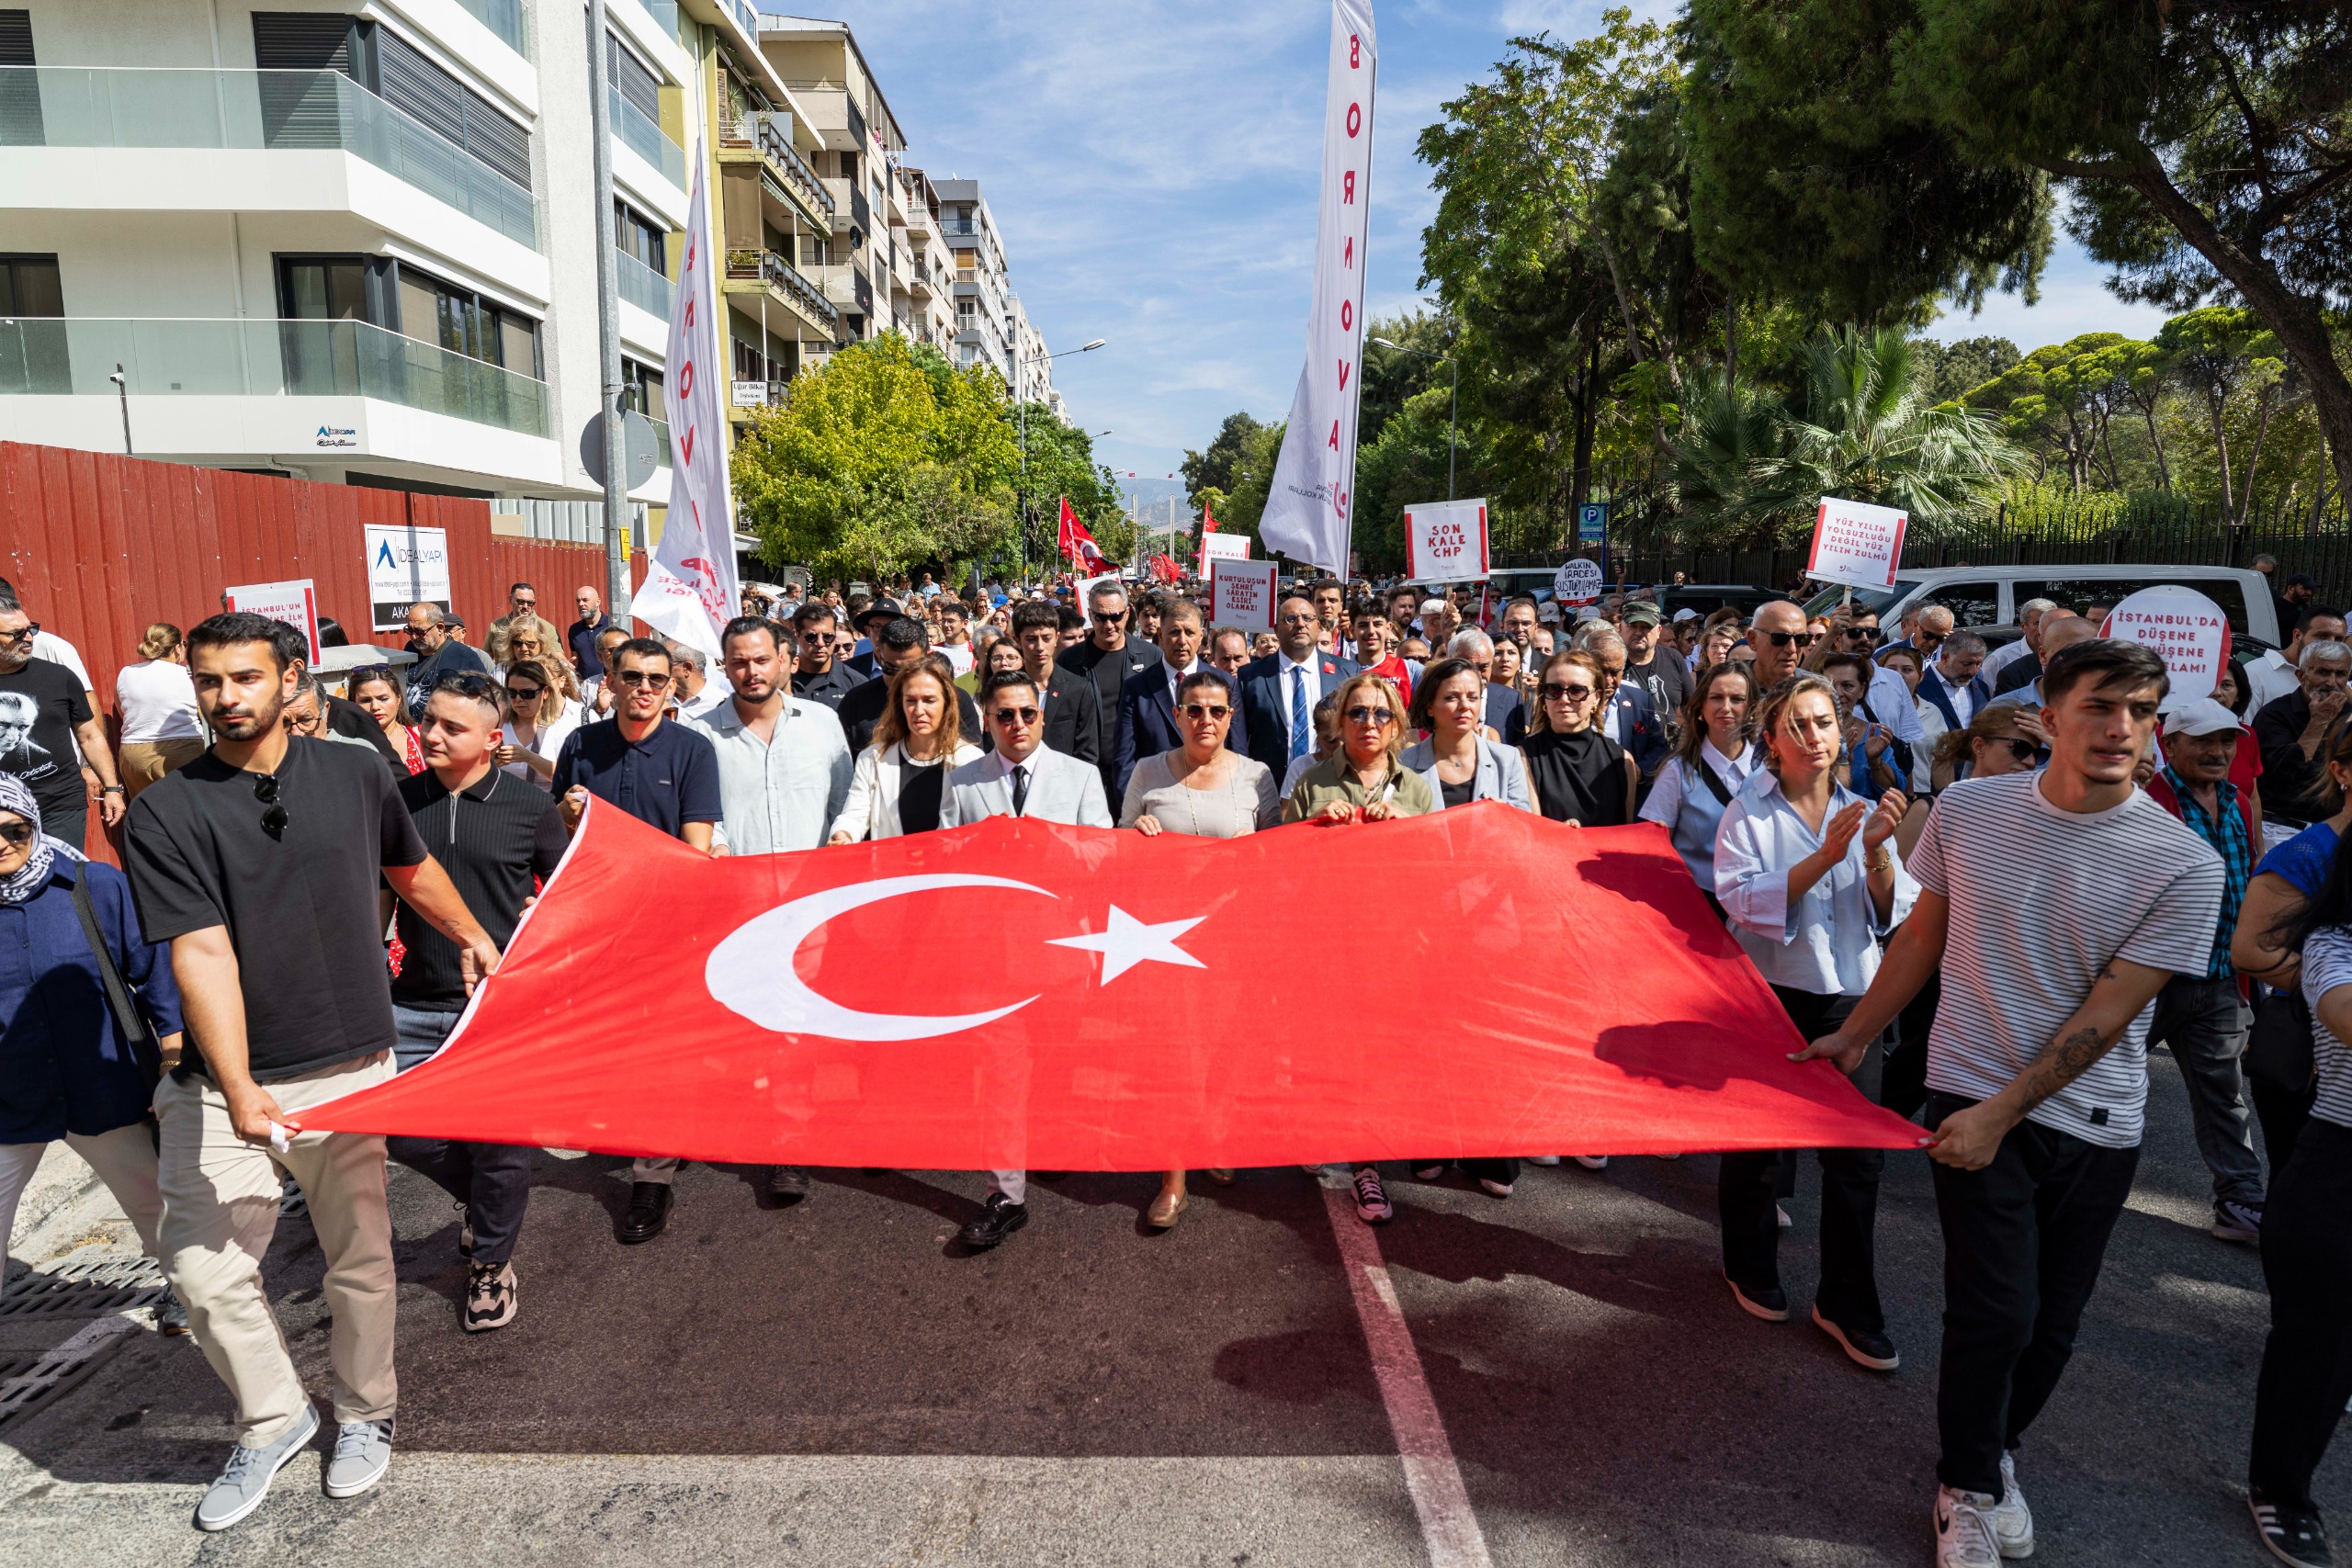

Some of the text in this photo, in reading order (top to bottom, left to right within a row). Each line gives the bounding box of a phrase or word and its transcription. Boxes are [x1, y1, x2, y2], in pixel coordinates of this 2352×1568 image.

[1588, 509, 1597, 521] P
[1431, 524, 1461, 536] SON
[1836, 517, 1886, 533] YÜZ YILIN
[1826, 525, 1891, 543] YOLSUZLUĞU
[1428, 535, 1465, 547] KALE
[1830, 536, 1883, 551] DEĞİL YÜZ
[1433, 547, 1461, 558] CHP
[1823, 543, 1888, 561] YILIN ZULMÜ
[1565, 561, 1591, 570] HALKIN
[1218, 574, 1267, 585] KURTULUŞUN
[1226, 589, 1259, 598] SARAYIN
[1226, 603, 1258, 612] OLAMAZ!
[2118, 609, 2219, 627] İSTANBUL'DA
[2137, 626, 2196, 642] DÜŞENE
